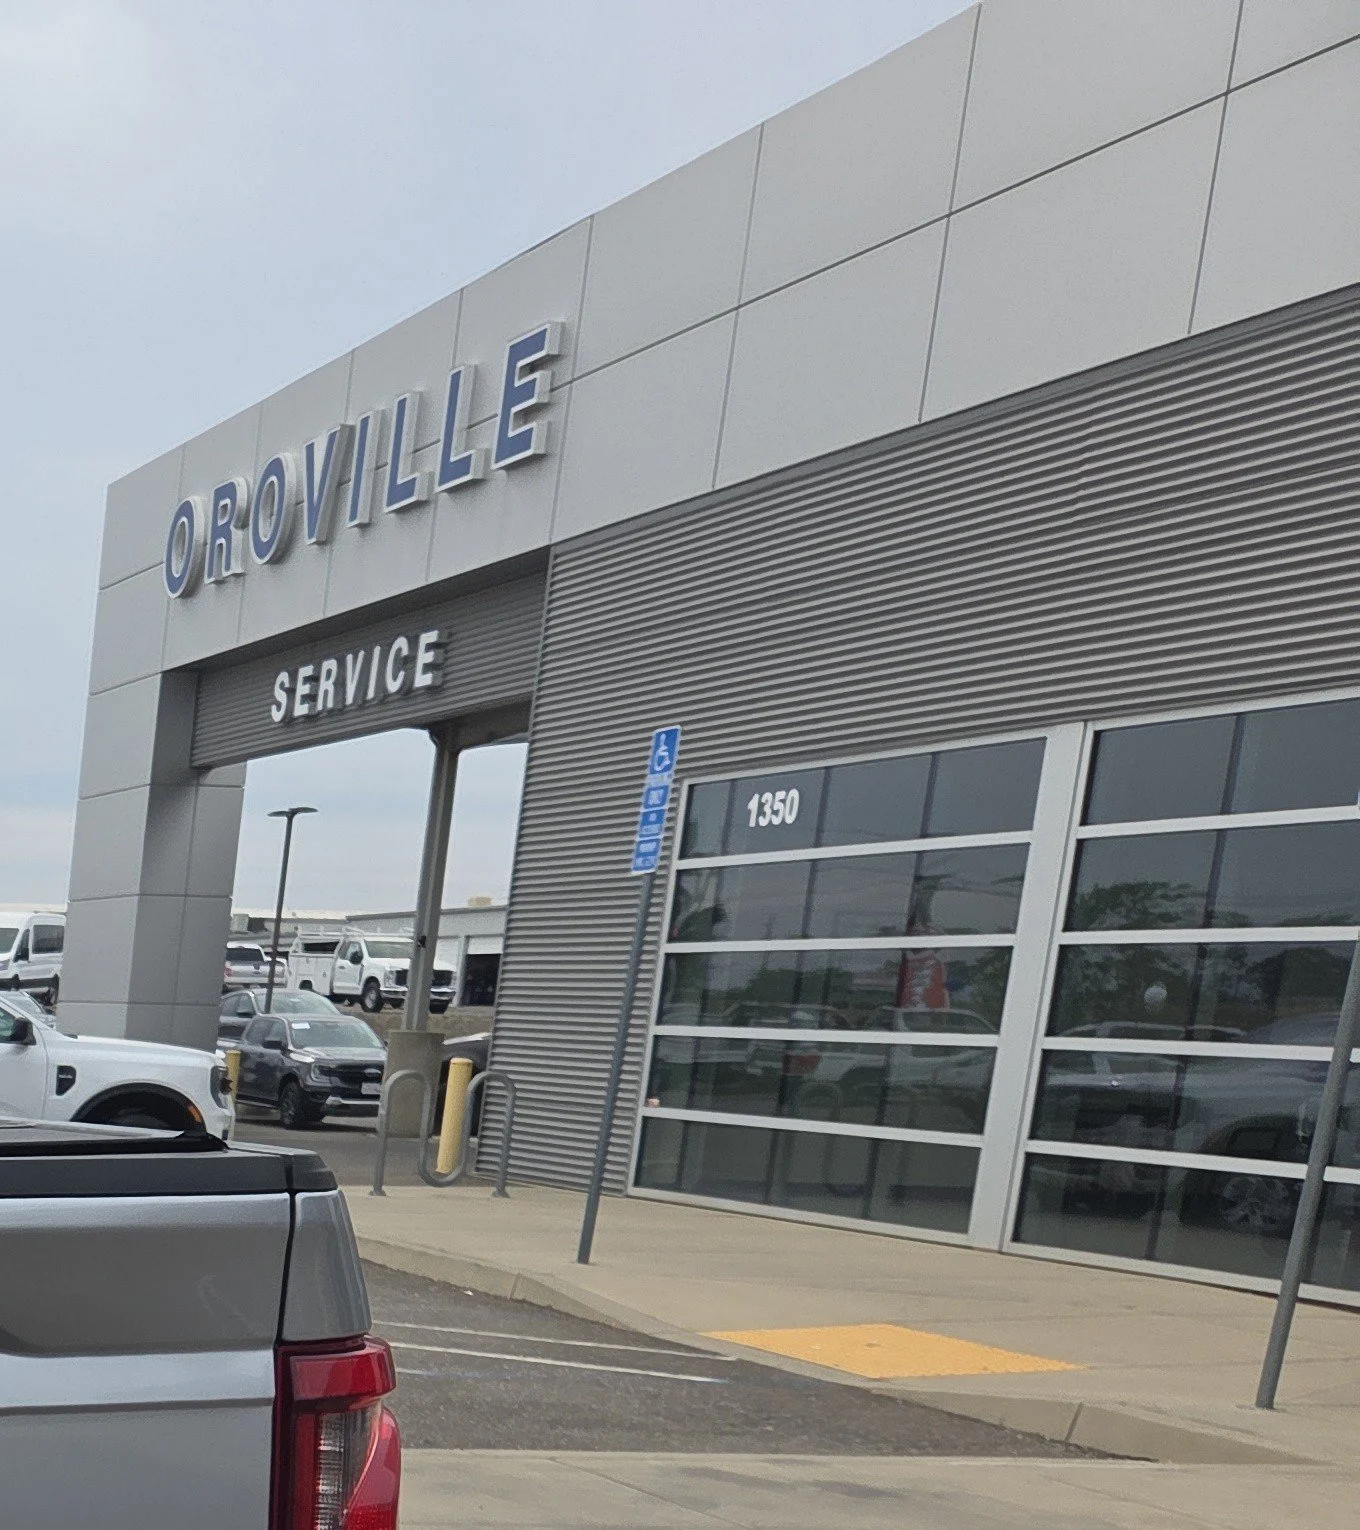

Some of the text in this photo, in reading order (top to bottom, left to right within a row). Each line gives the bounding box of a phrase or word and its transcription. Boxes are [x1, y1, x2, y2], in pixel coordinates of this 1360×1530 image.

[163, 320, 567, 600] OROVILLE
[270, 629, 444, 723] SERVICE
[747, 788, 800, 828] 1350
